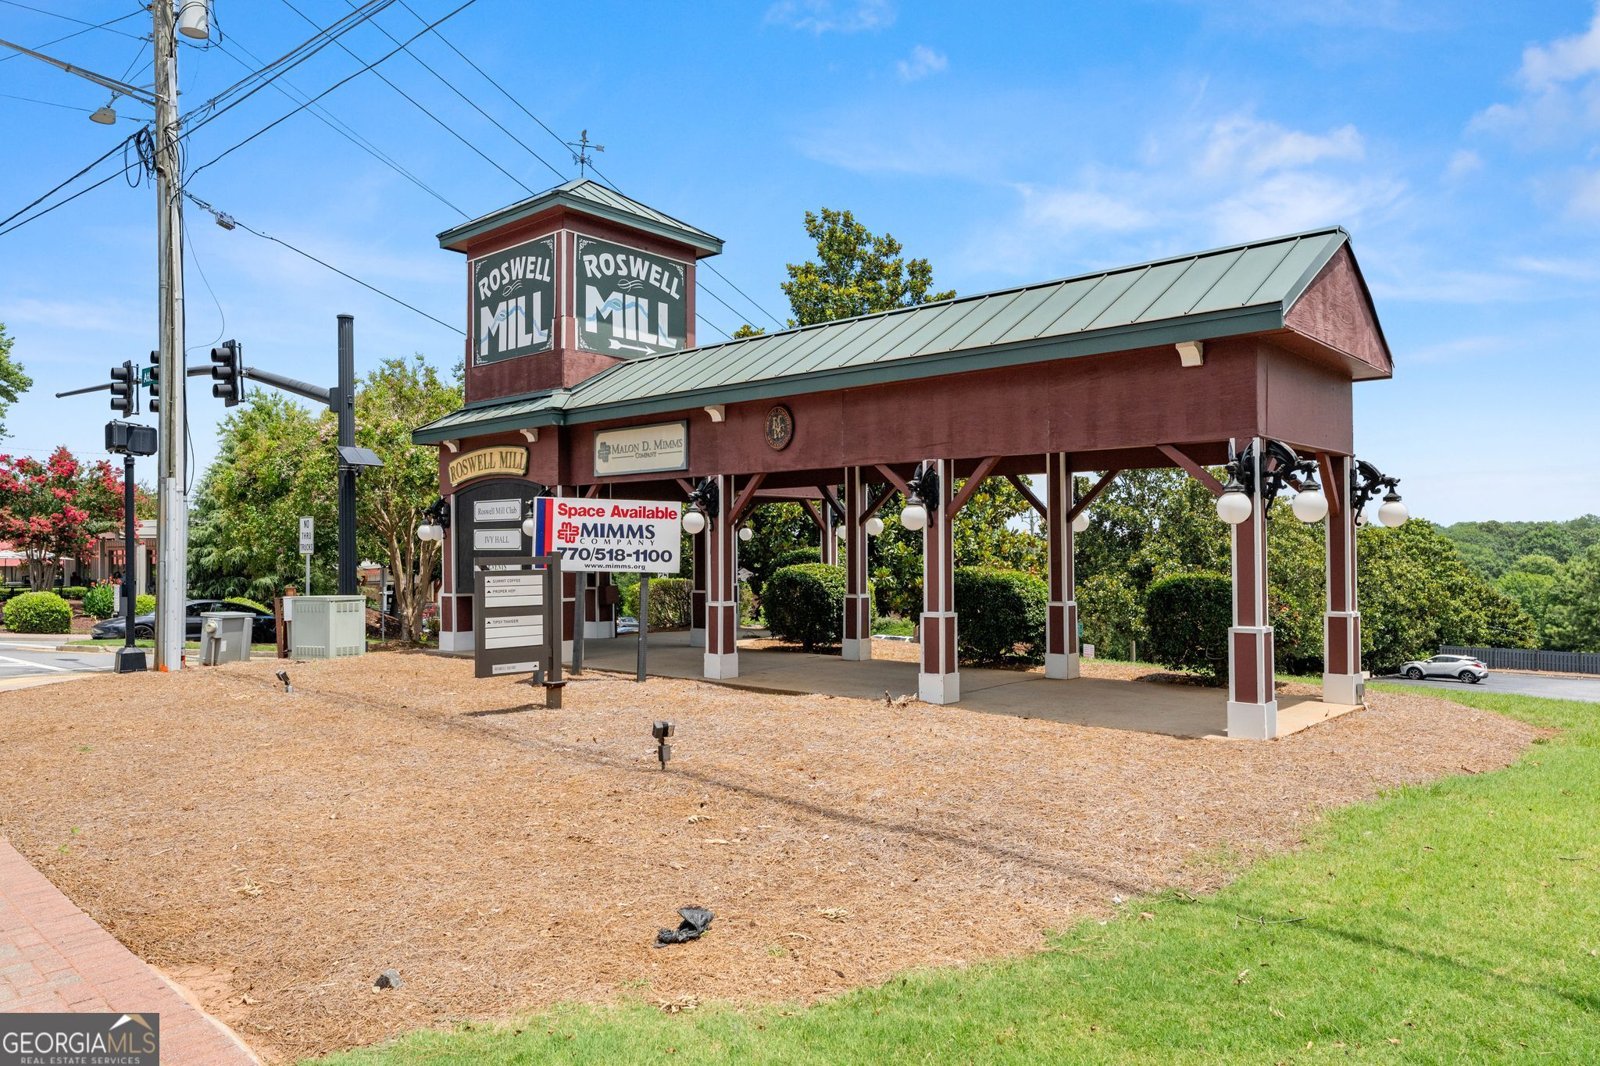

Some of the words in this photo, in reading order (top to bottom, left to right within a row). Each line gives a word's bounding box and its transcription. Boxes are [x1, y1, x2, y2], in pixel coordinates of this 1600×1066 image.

[478, 256, 551, 300] ROSWELL
[582, 253, 680, 300] ROSWELL
[480, 291, 549, 356] MILL
[585, 284, 678, 349] MILL
[612, 443, 640, 455] MALON
[642, 440, 651, 452] D.
[654, 438, 683, 450] MIMMS
[450, 452, 496, 482] ROSWELL
[499, 451, 525, 470] MILL
[477, 506, 495, 515] Roswell
[495, 506, 505, 515] Mill
[506, 506, 518, 514] Club
[557, 503, 606, 519] Space
[610, 505, 678, 520] Available
[303, 519, 310, 528] NO
[580, 522, 656, 540] MIMMS
[484, 536, 494, 544] IVY
[495, 535, 509, 543] HALL
[579, 538, 655, 546] COMPANY
[557, 547, 673, 562] 770/518-1100
[584, 563, 646, 571] www.mimms.org
